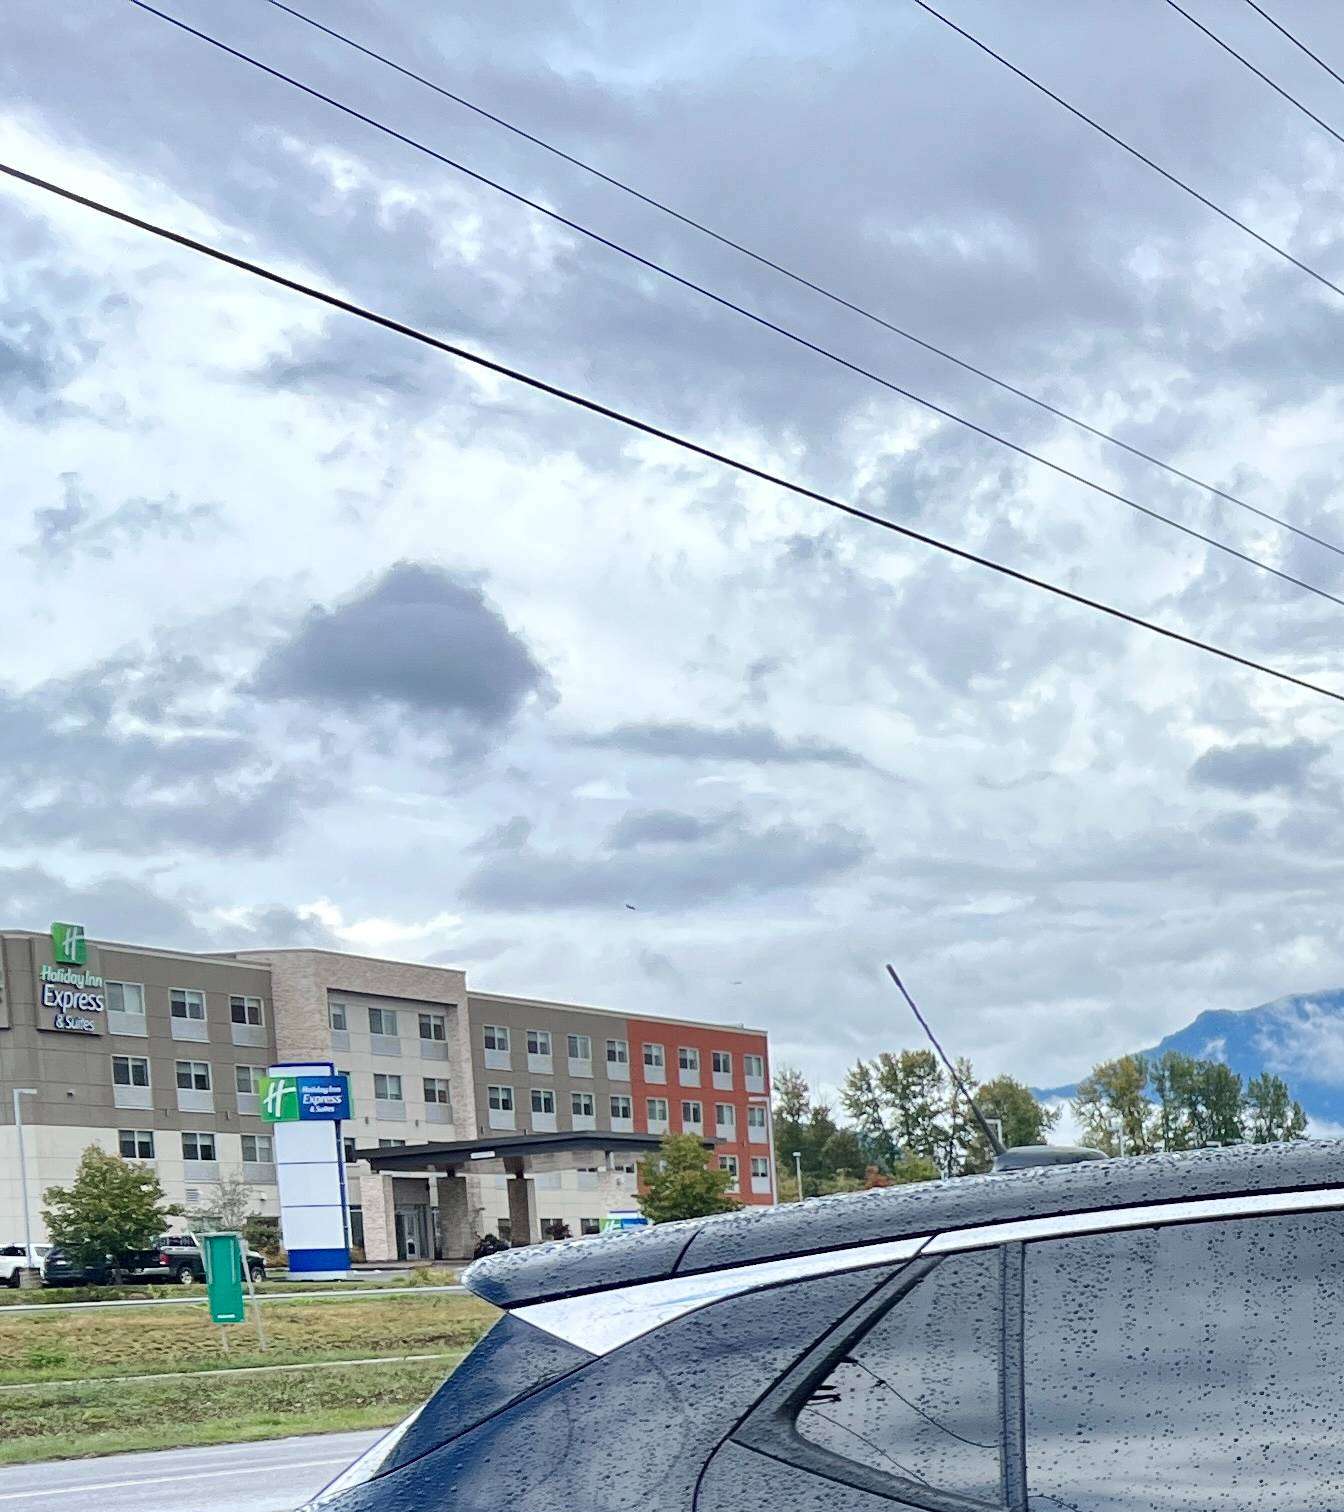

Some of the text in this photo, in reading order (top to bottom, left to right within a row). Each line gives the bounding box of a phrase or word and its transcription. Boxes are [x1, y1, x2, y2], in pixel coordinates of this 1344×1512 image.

[40, 964, 103, 989] Holiday Inn
[43, 983, 105, 1013] Express
[65, 1015, 96, 1032] Suites
